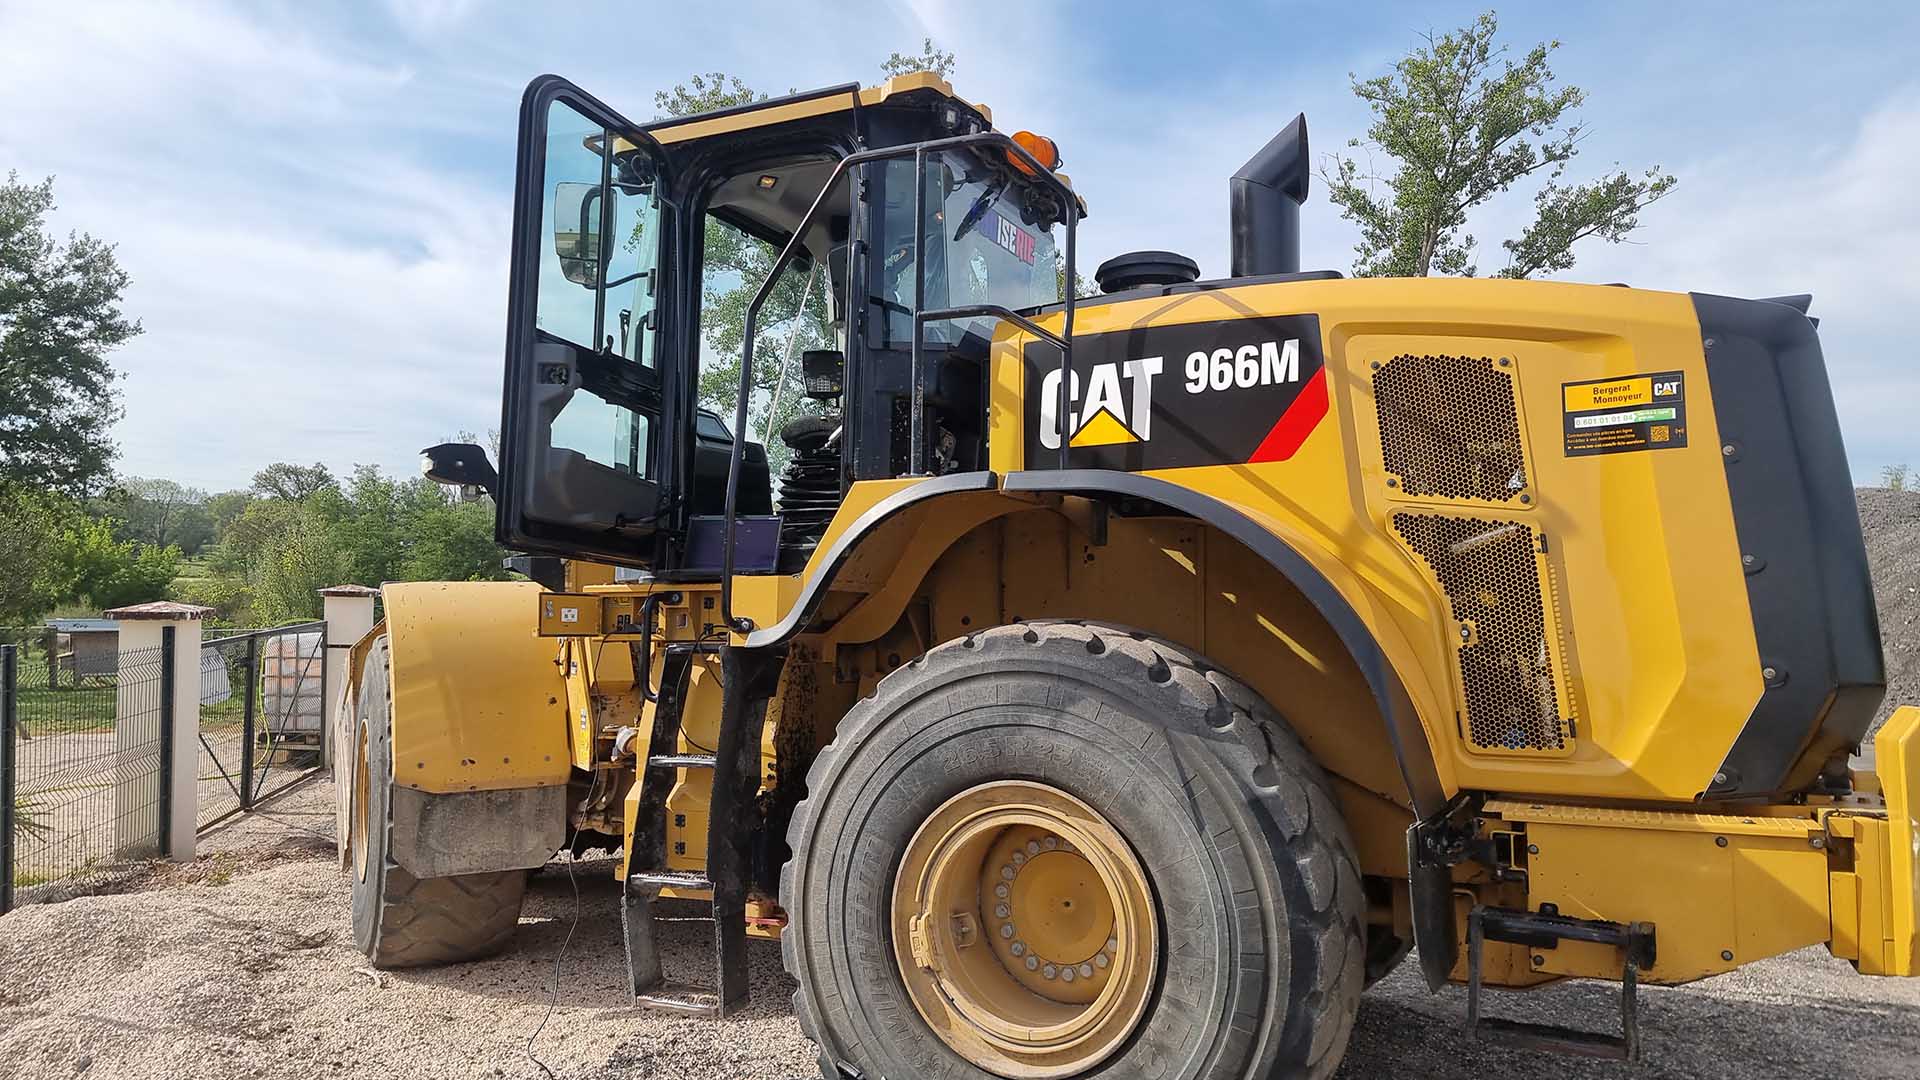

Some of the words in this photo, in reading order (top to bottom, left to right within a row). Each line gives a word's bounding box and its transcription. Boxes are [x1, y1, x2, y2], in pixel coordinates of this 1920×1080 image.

[1040, 356, 1163, 449] CAT
[1185, 339, 1299, 394] 966M
[1593, 384, 1631, 395] Bergerat
[1654, 381, 1680, 396] CAT
[1593, 392, 1642, 404] Monnoyeur
